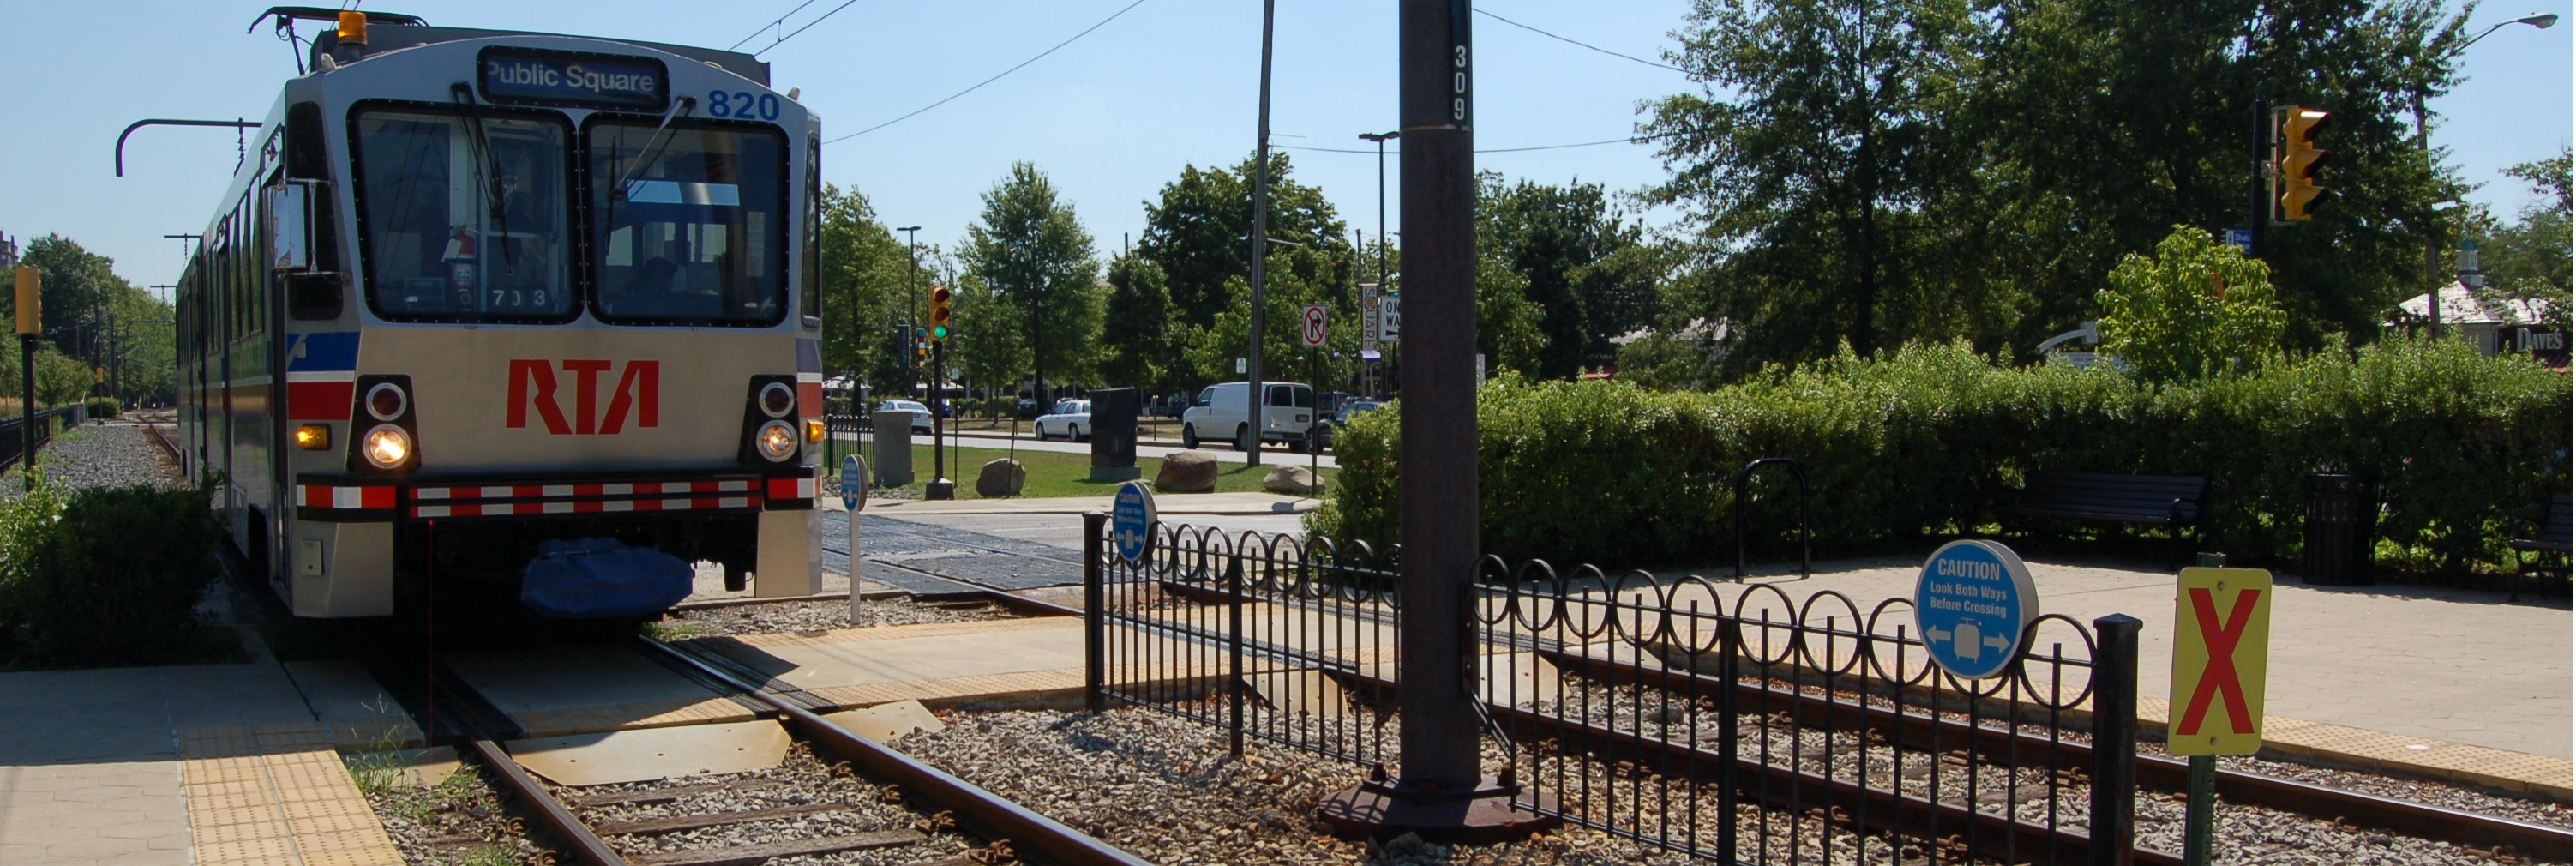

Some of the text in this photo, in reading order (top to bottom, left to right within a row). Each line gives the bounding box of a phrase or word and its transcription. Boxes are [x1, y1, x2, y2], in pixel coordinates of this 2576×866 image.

[488, 61, 655, 93] Public Square
[1455, 45, 1467, 120] 309
[708, 89, 780, 121] 820
[1385, 301, 1401, 313] ON
[1385, 315, 1401, 327] WA
[506, 359, 659, 436] RTA
[1937, 558, 2000, 581] CAUTION
[1930, 580, 2007, 602] Look Both Ways
[1930, 596, 2007, 619] Before Crossing
